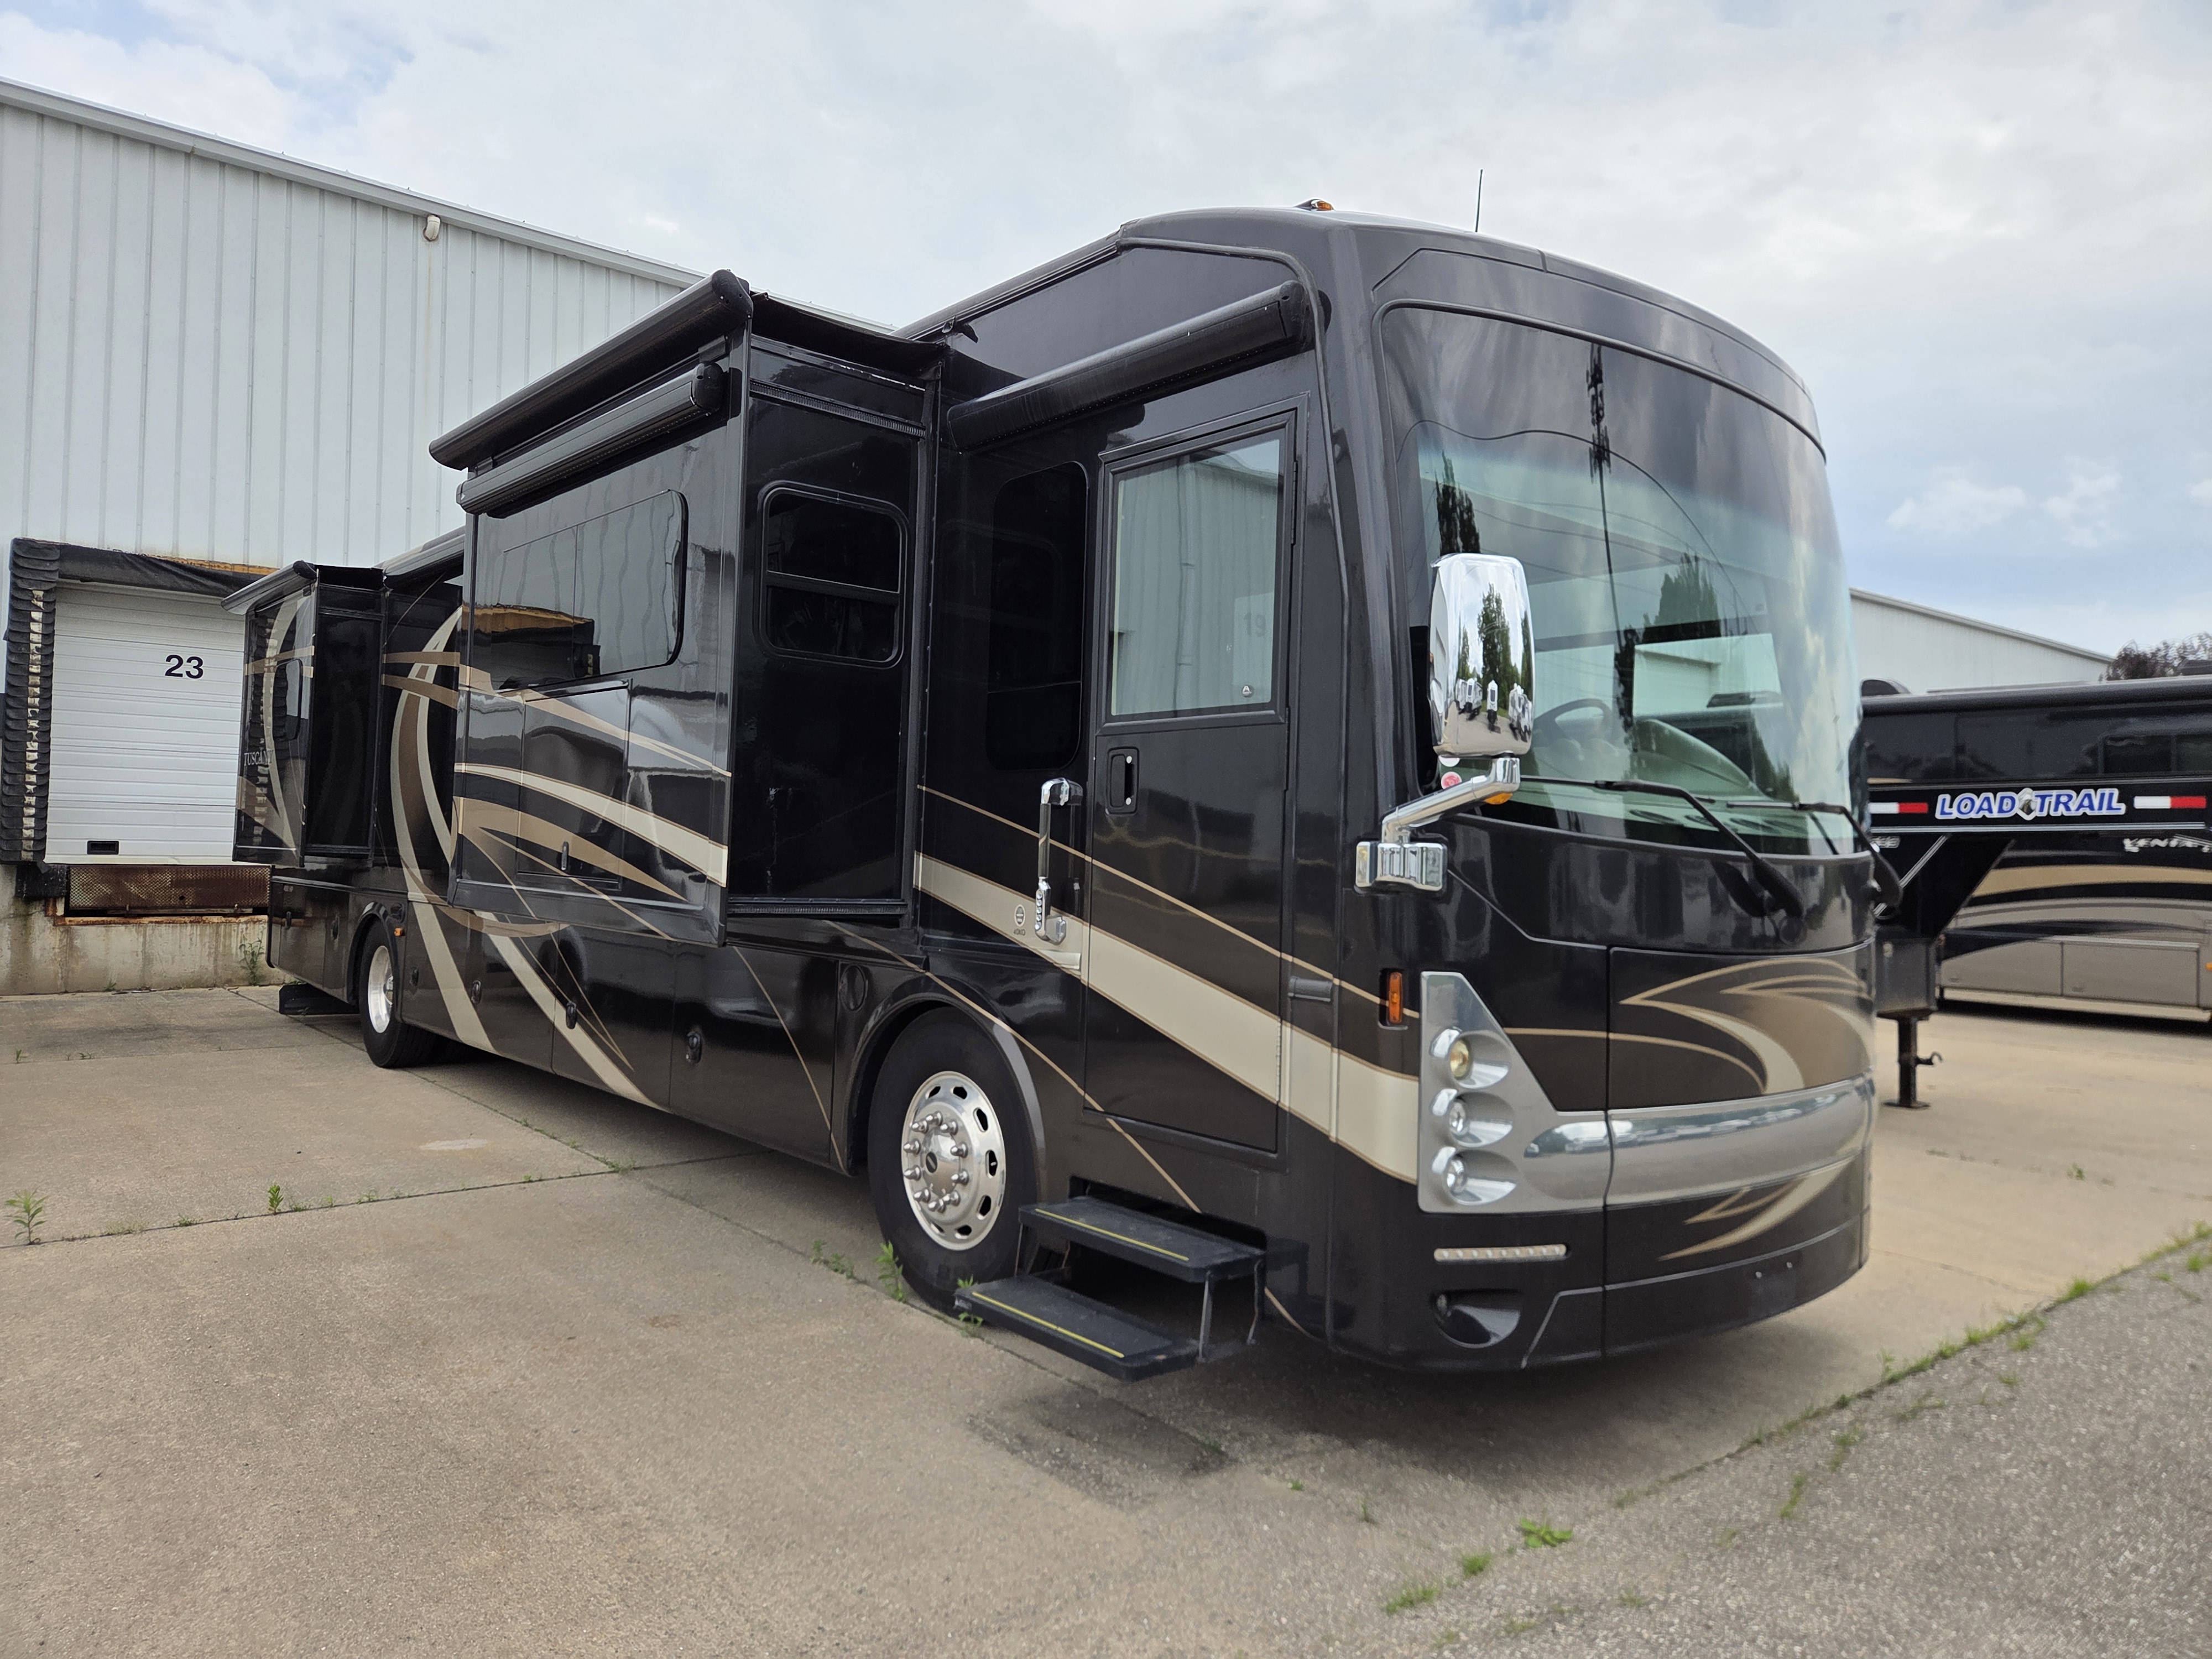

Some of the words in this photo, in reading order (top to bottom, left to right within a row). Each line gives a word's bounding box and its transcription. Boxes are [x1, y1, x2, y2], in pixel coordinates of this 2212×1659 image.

[164, 654, 204, 679] 23
[243, 749, 274, 766] TUSCANY
[1937, 793, 2017, 817] LOAD
[2033, 790, 2124, 815] TRAIL
